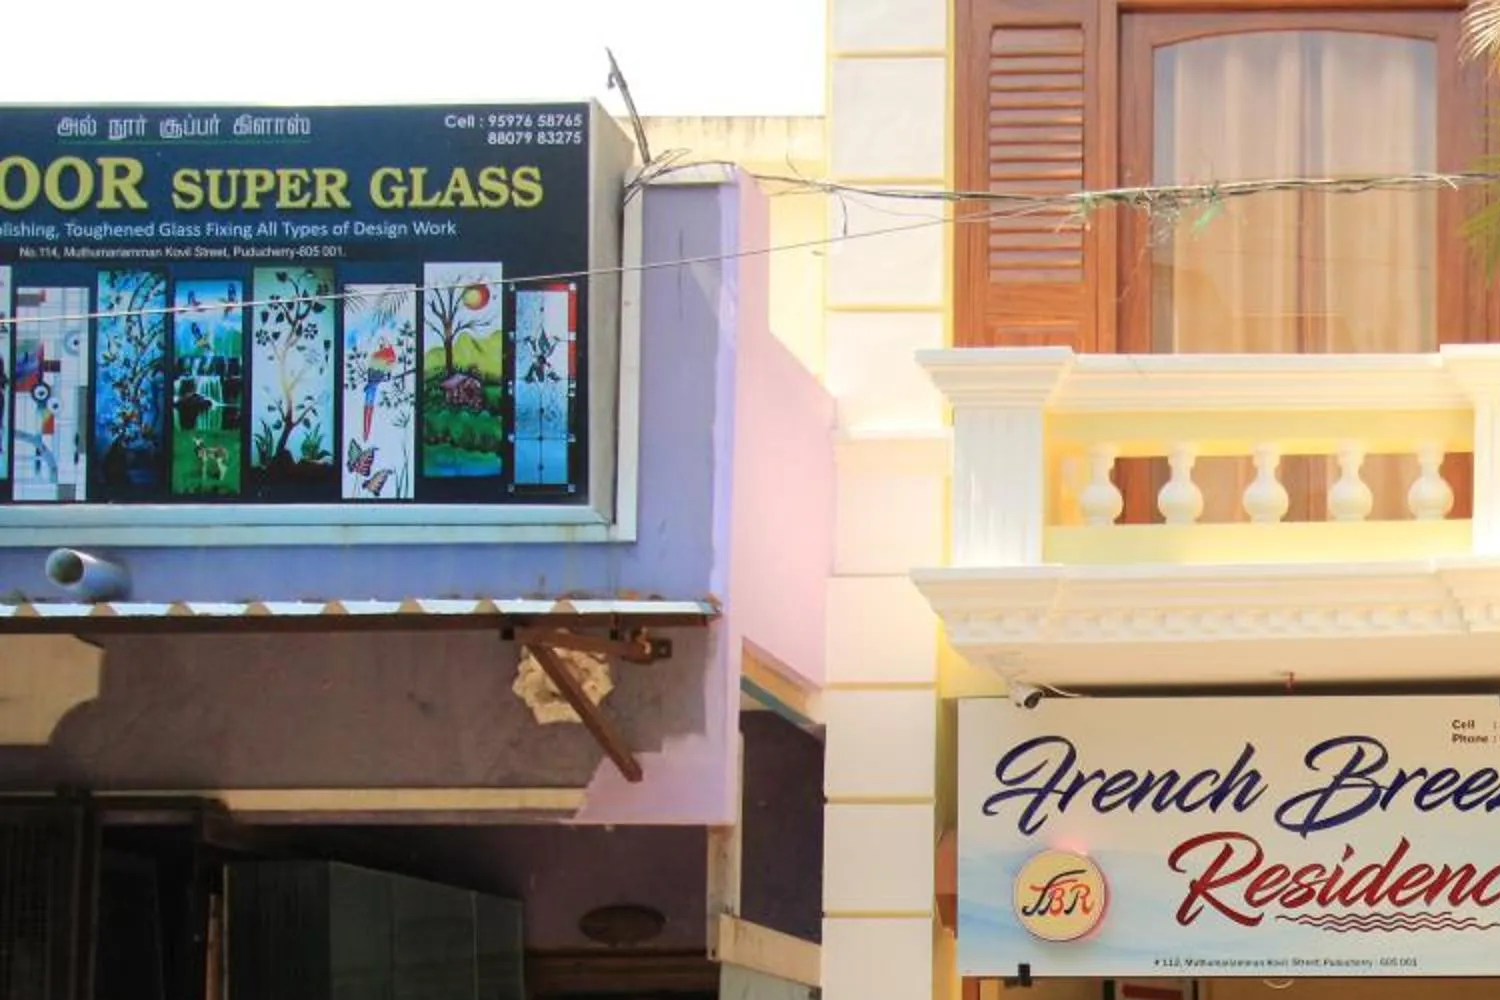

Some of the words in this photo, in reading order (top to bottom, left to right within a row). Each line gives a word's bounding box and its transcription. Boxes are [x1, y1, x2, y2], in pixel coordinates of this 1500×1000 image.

[444, 114, 475, 129] Cell
[487, 114, 533, 128] 95976
[537, 113, 584, 128] 58765
[487, 131, 532, 145] 88079
[537, 131, 582, 145] 83275
[172, 167, 352, 210] SUPER
[370, 166, 544, 209] GLASS
[0, 220, 61, 240] lishing,
[65, 222, 154, 241] Toughened
[159, 222, 200, 238] Glass
[206, 221, 253, 240] Fixing
[256, 221, 278, 237] All
[282, 221, 328, 239] Types
[332, 220, 351, 236] of
[354, 221, 408, 239] Design
[413, 220, 457, 236] Work
[1451, 719, 1476, 730] Cell
[1452, 733, 1489, 743] Phone
[982, 735, 1271, 836] French
